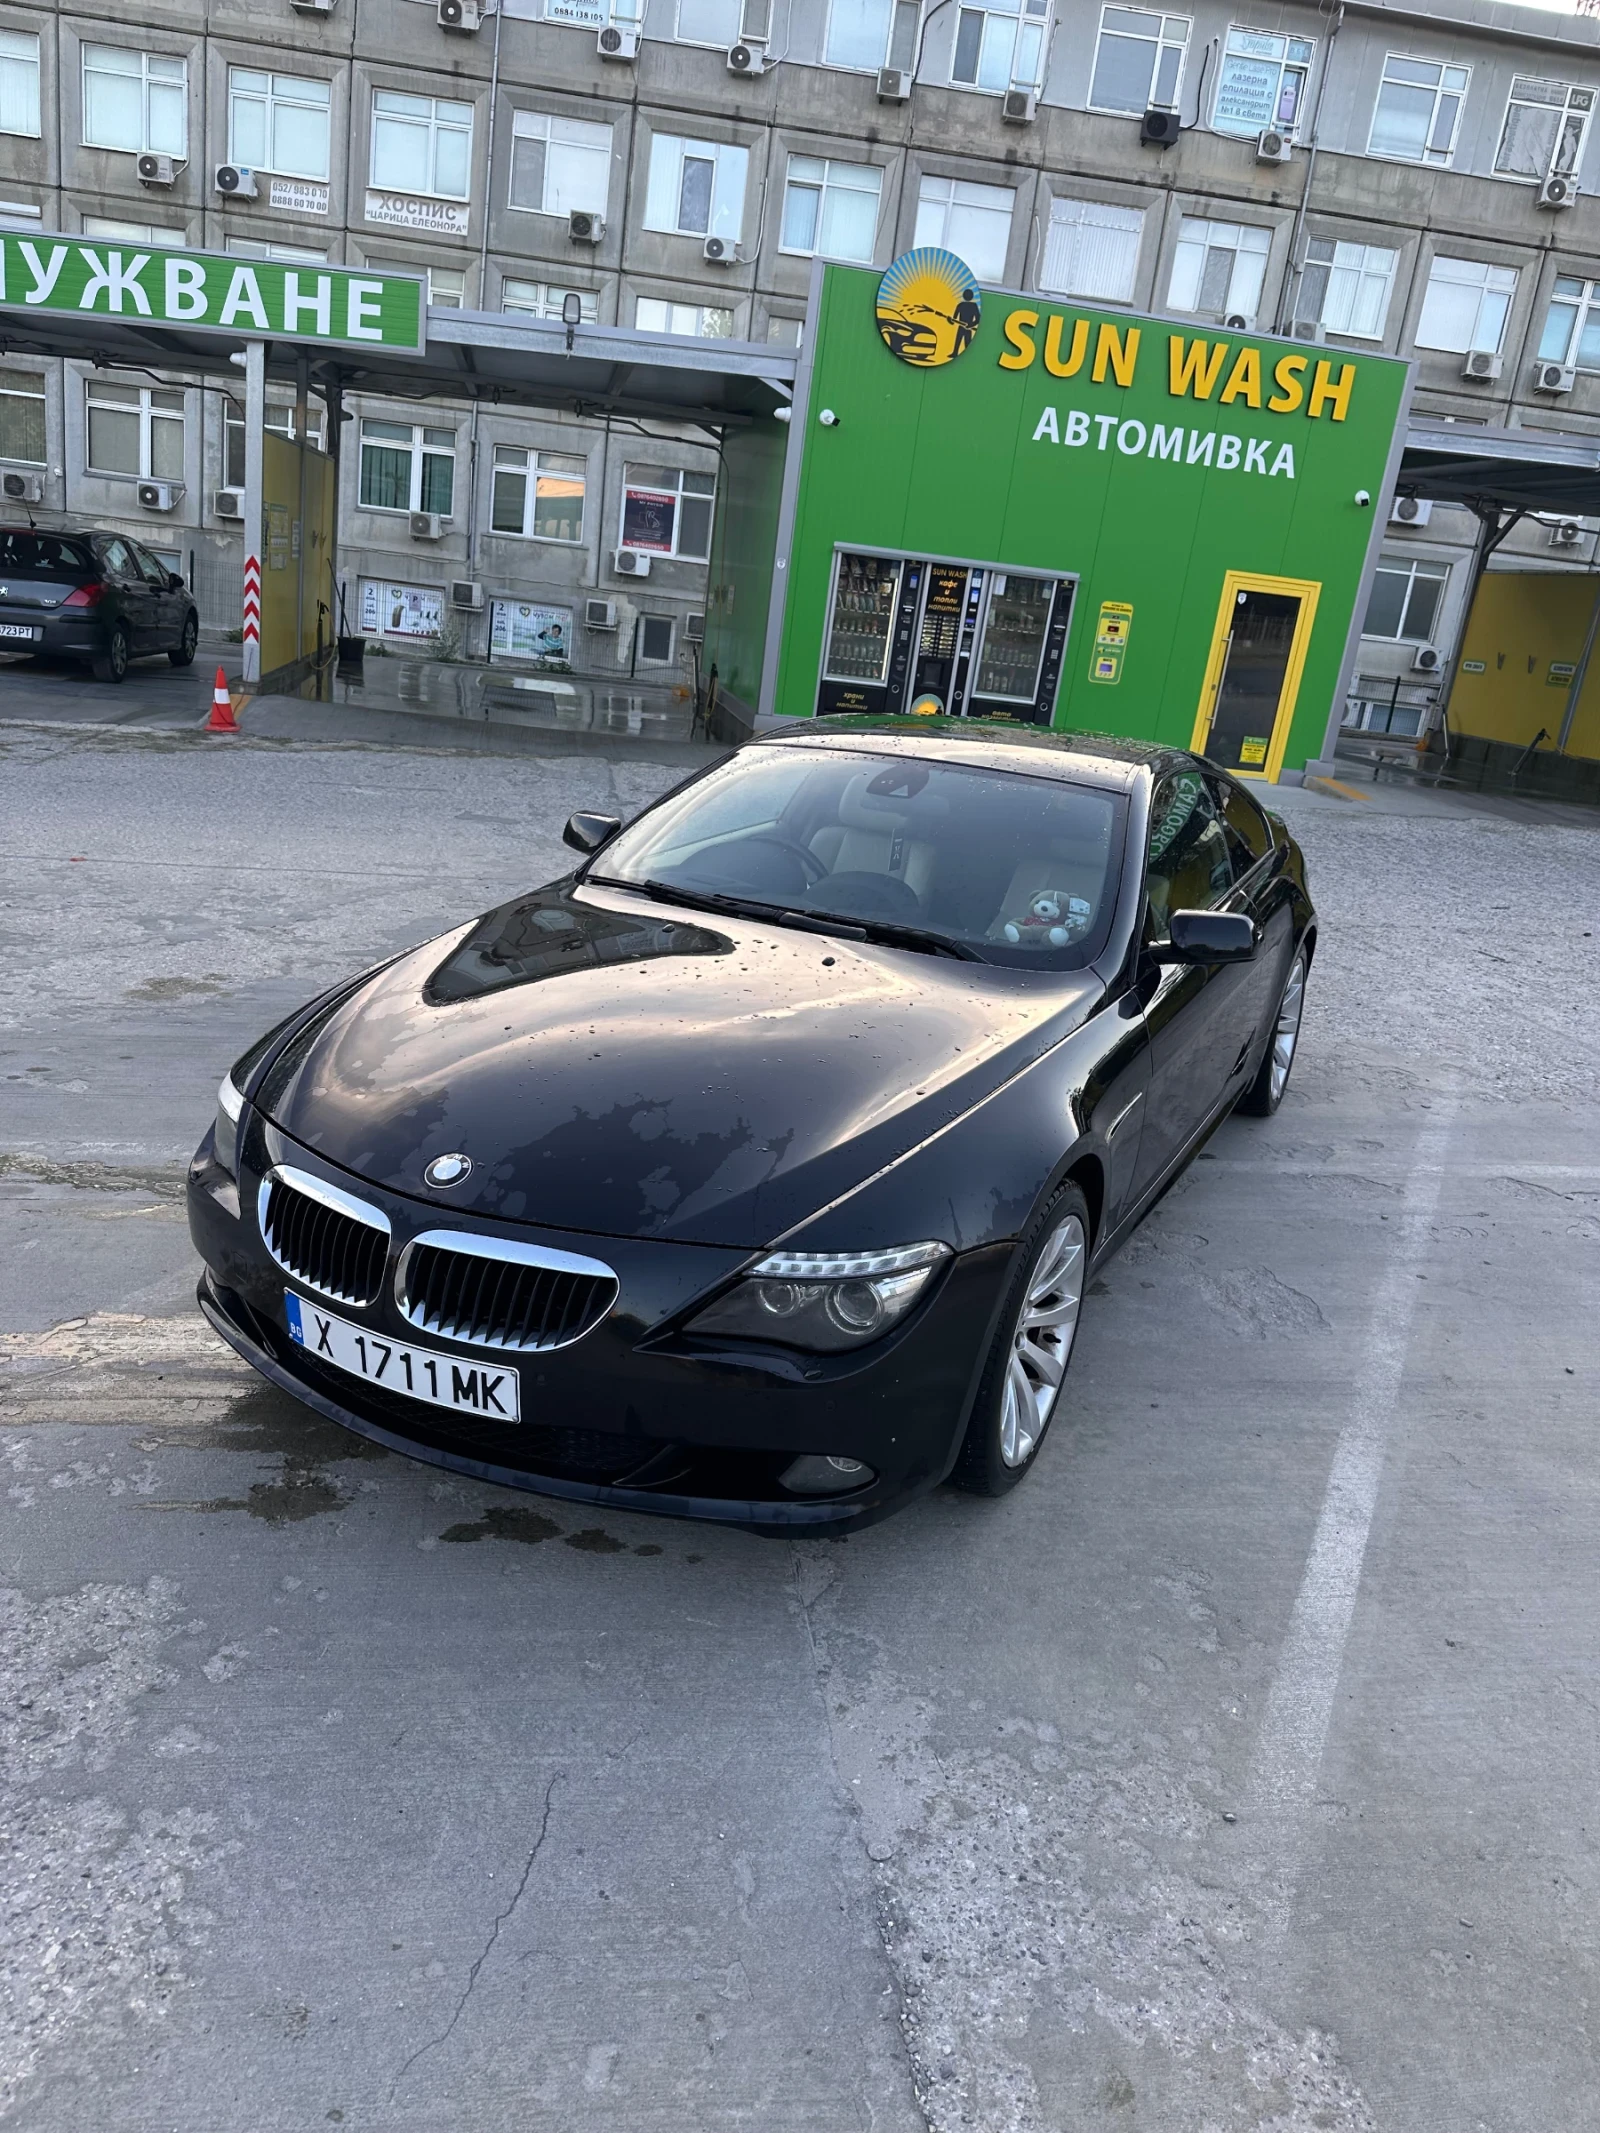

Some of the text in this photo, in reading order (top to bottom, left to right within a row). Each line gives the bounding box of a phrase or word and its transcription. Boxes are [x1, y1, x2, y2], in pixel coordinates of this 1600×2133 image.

[590, 13, 603, 21] 105
[1230, 73, 1268, 85] лазерна
[1222, 84, 1266, 98] епилация
[1221, 96, 1270, 110] александрит
[1570, 93, 1589, 106] LPG
[1242, 110, 1267, 120] света
[379, 196, 457, 221] ХОСПИС
[0, 240, 383, 340] УЖВАНЕ
[998, 308, 1357, 422] SUN WASH
[1032, 406, 1296, 479] АВТОМИВКА
[932, 568, 968, 579] SUN WASH
[0, 626, 17, 636] 723
[289, 1321, 302, 1338] BG
[315, 1313, 508, 1415] X 1711 MK
